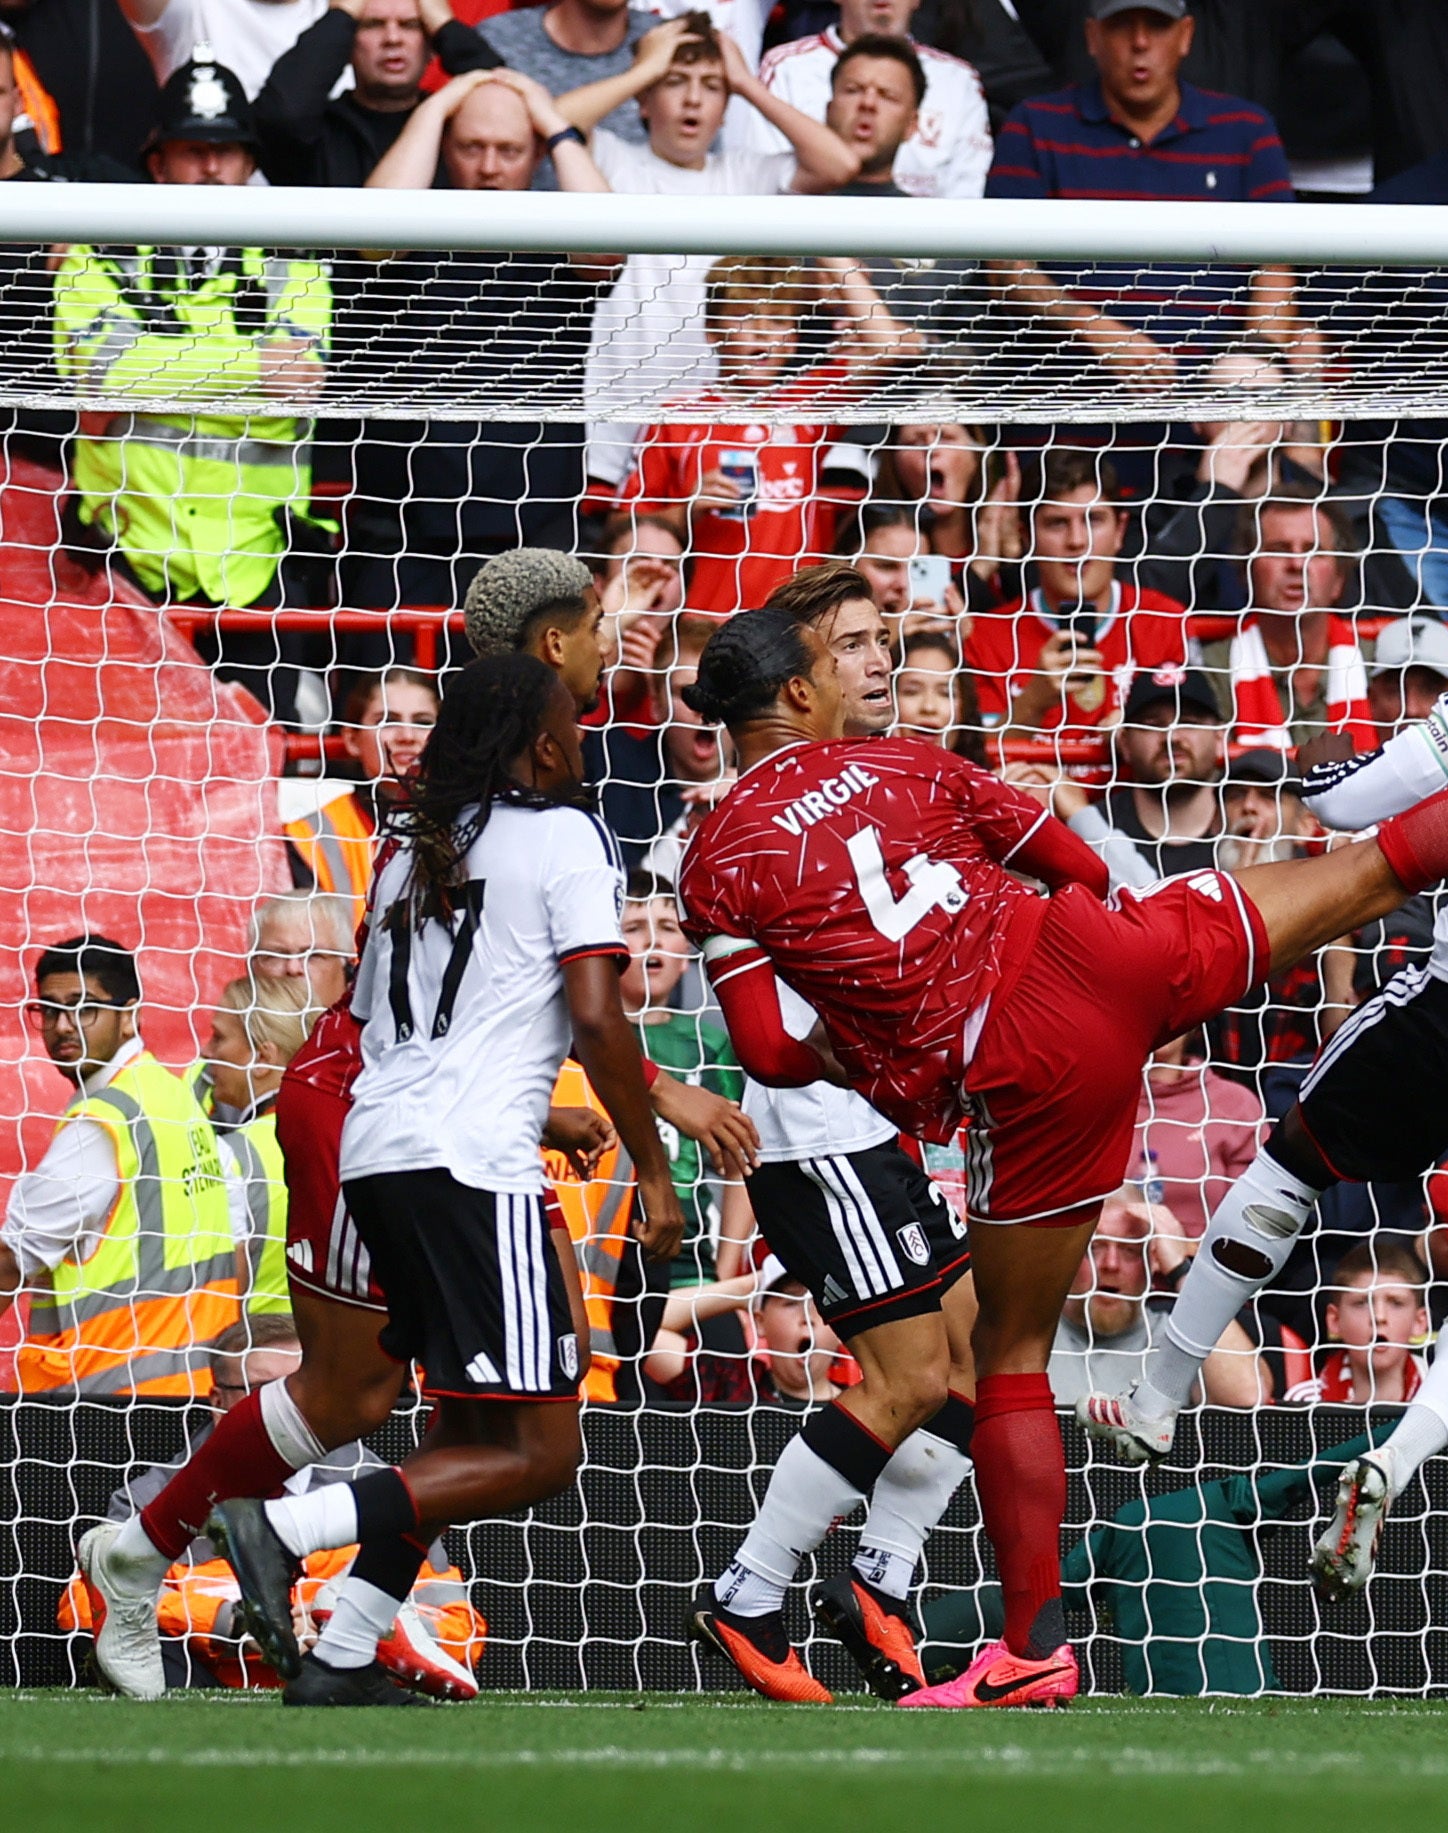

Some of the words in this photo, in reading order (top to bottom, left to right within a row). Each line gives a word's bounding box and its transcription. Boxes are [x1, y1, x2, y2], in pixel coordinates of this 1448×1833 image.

[771, 764, 880, 836] VIRGIL
[846, 824, 971, 943] 4
[386, 878, 487, 1044] 17
